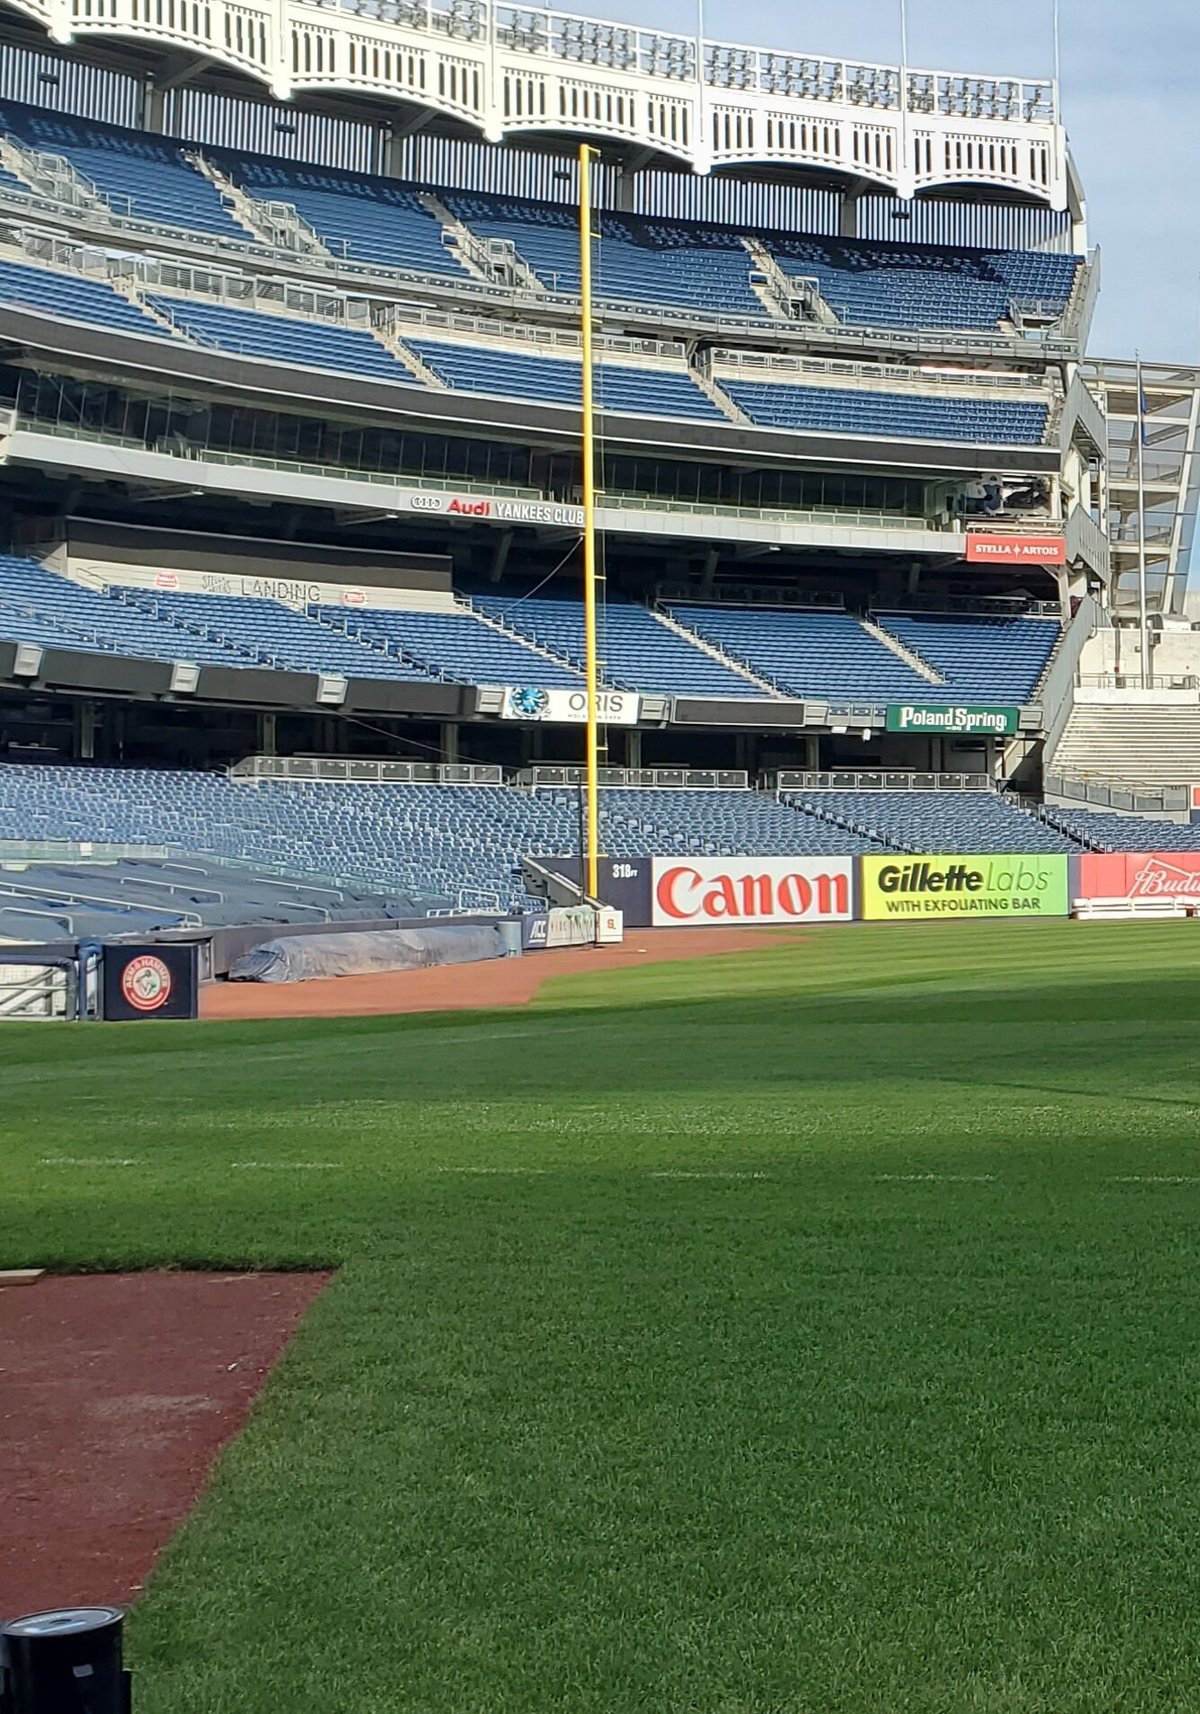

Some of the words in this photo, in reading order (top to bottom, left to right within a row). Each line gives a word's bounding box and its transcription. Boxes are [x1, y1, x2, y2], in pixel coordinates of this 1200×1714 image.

[447, 498, 491, 516] Audi
[496, 502, 551, 522] YANKEES
[553, 510, 584, 525] CLUB
[975, 544, 1011, 554] STELLA
[1022, 545, 1059, 556] ARTOIS
[241, 578, 320, 602] LANDING
[900, 706, 954, 728] Poland
[954, 708, 1007, 731] Spring
[877, 863, 984, 893] Gillette
[986, 861, 1049, 891] Labs
[656, 866, 849, 919] Canon
[886, 900, 921, 912] WITH
[925, 898, 1009, 912] EXFOLIATING
[1012, 897, 1041, 910] BAR
